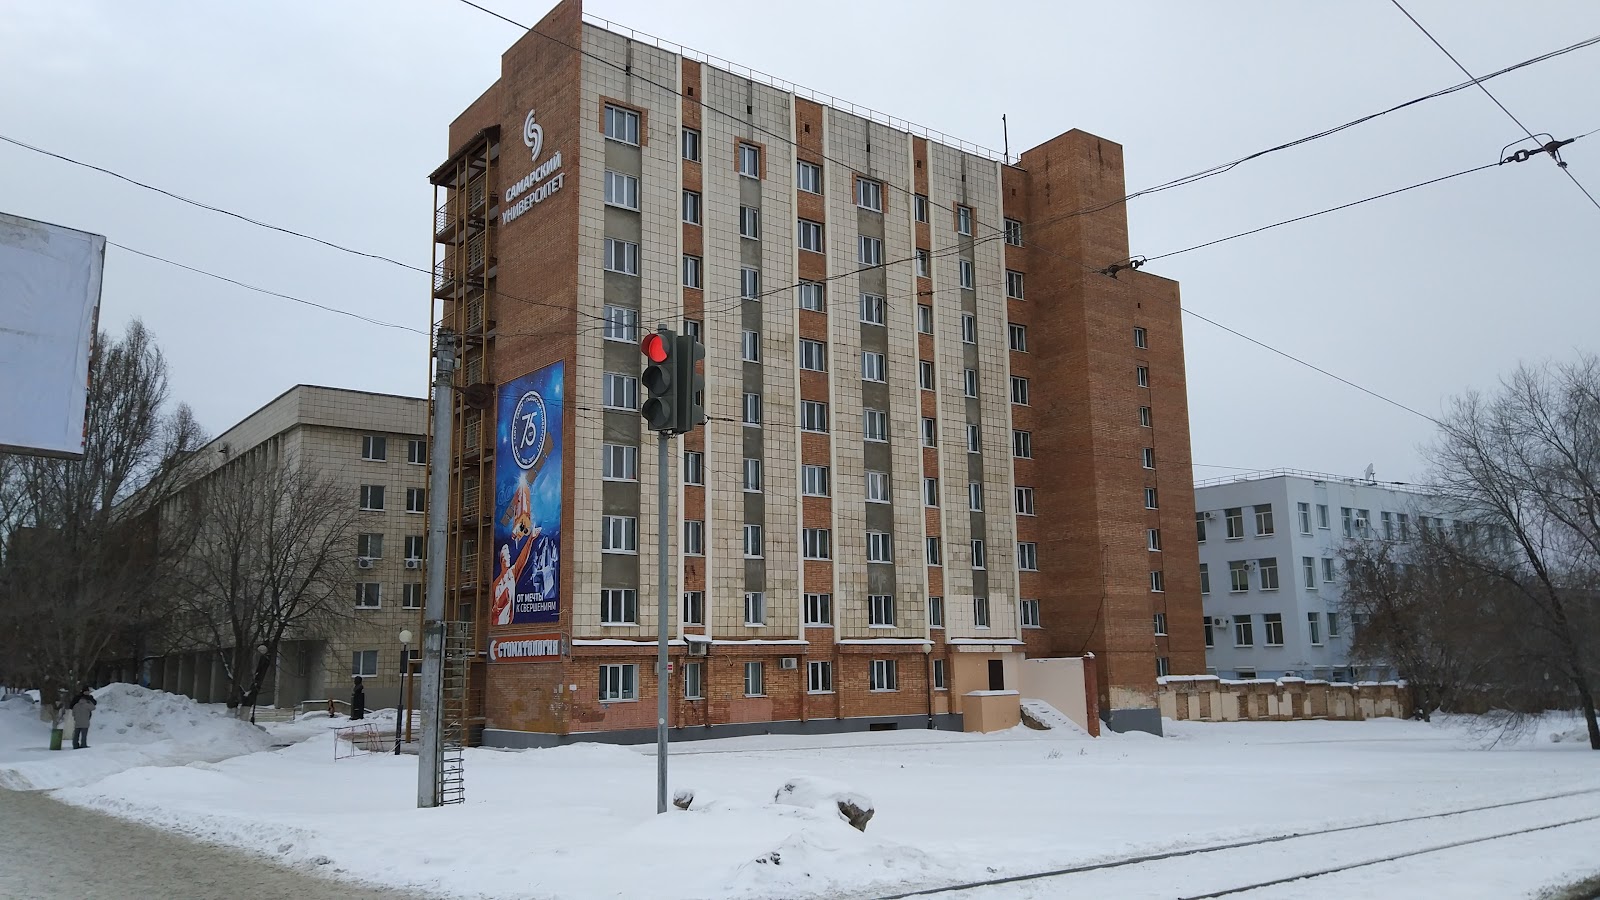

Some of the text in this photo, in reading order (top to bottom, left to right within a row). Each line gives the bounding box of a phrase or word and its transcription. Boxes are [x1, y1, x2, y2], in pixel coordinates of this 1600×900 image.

[505, 150, 562, 202] САМАРСКИЙ
[502, 172, 565, 225] УНИВЕРСИТЕТ
[520, 411, 538, 449] 75
[516, 602, 556, 612] К СВЕРШЕНИЯМ
[517, 593, 544, 602] ОТ МЕЧТЫ
[498, 640, 559, 657] СТОМАТОЛОГИЯ
